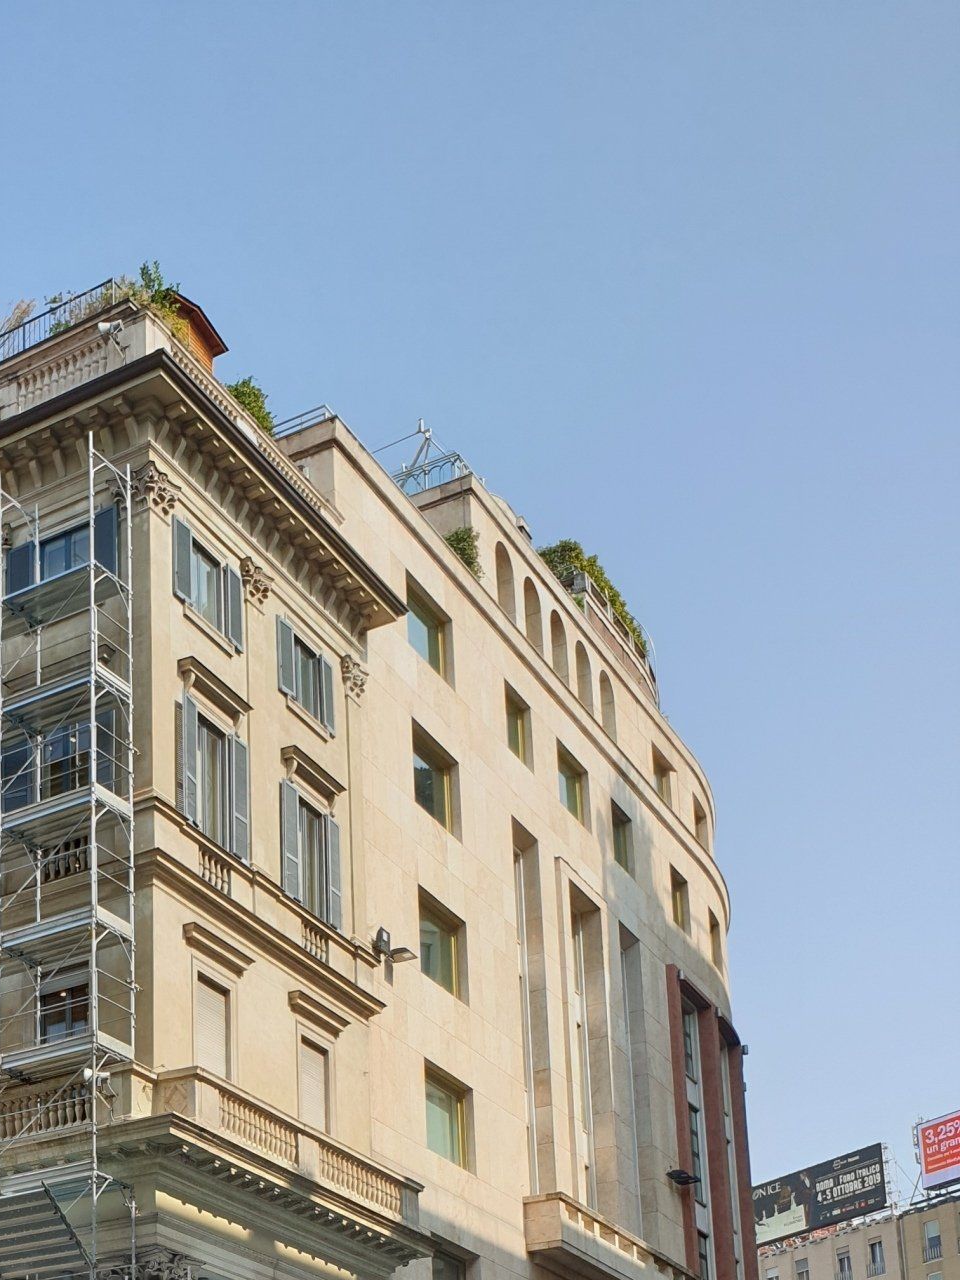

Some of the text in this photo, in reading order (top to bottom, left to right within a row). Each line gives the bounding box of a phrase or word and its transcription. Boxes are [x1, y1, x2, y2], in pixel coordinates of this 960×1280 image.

[926, 1144, 938, 1154] un
[767, 1182, 781, 1194] ICE
[832, 1178, 863, 1198] OTTOBRE
[863, 1172, 881, 1188] 2019
